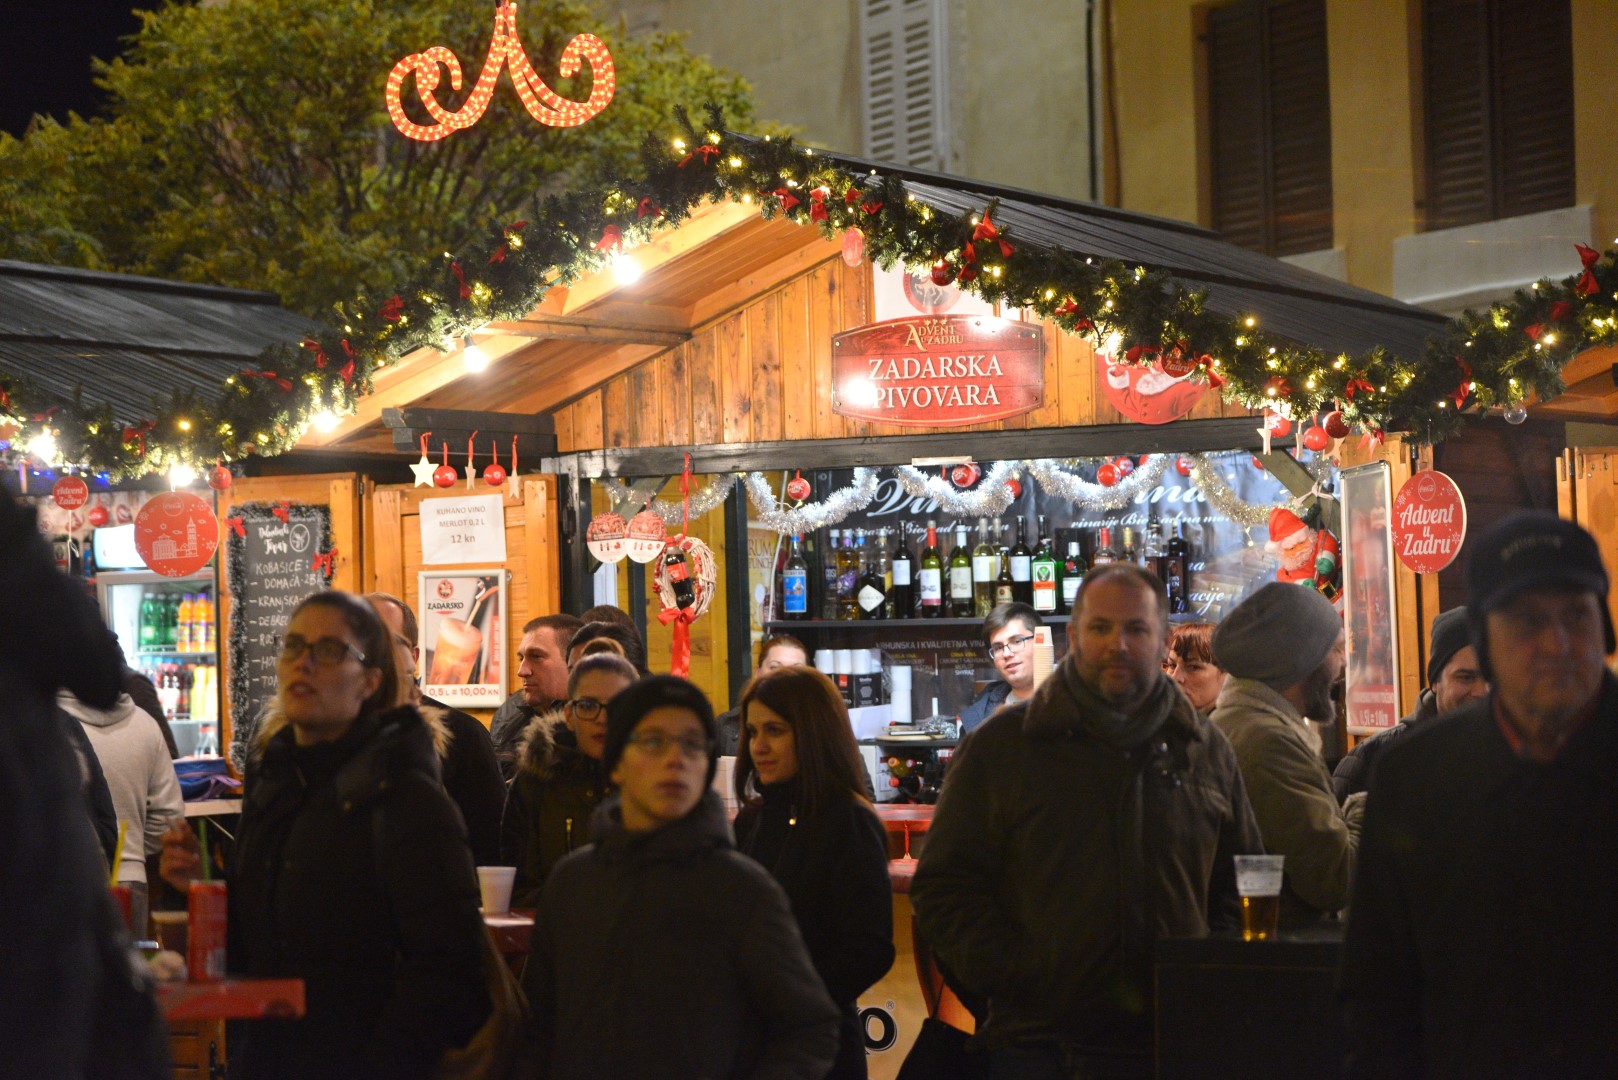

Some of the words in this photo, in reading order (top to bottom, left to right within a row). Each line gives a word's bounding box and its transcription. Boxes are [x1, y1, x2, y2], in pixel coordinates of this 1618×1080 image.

[928, 335, 964, 345] ZADRU
[868, 354, 1003, 380] ZADARSKA
[872, 384, 1001, 409] PIVOVARA
[436, 507, 466, 515] KUHANO
[467, 505, 486, 513] VINO
[1400, 503, 1454, 529] Advent
[439, 519, 467, 527] MERLOT
[1423, 525, 1430, 538] u
[451, 534, 462, 544] 12
[464, 533, 476, 543] kn
[748, 539, 773, 557] RUM
[1403, 534, 1451, 556] Zadru
[427, 602, 464, 610] ZADARSKO
[429, 687, 444, 697] 0,5
[460, 687, 487, 697] 10,00
